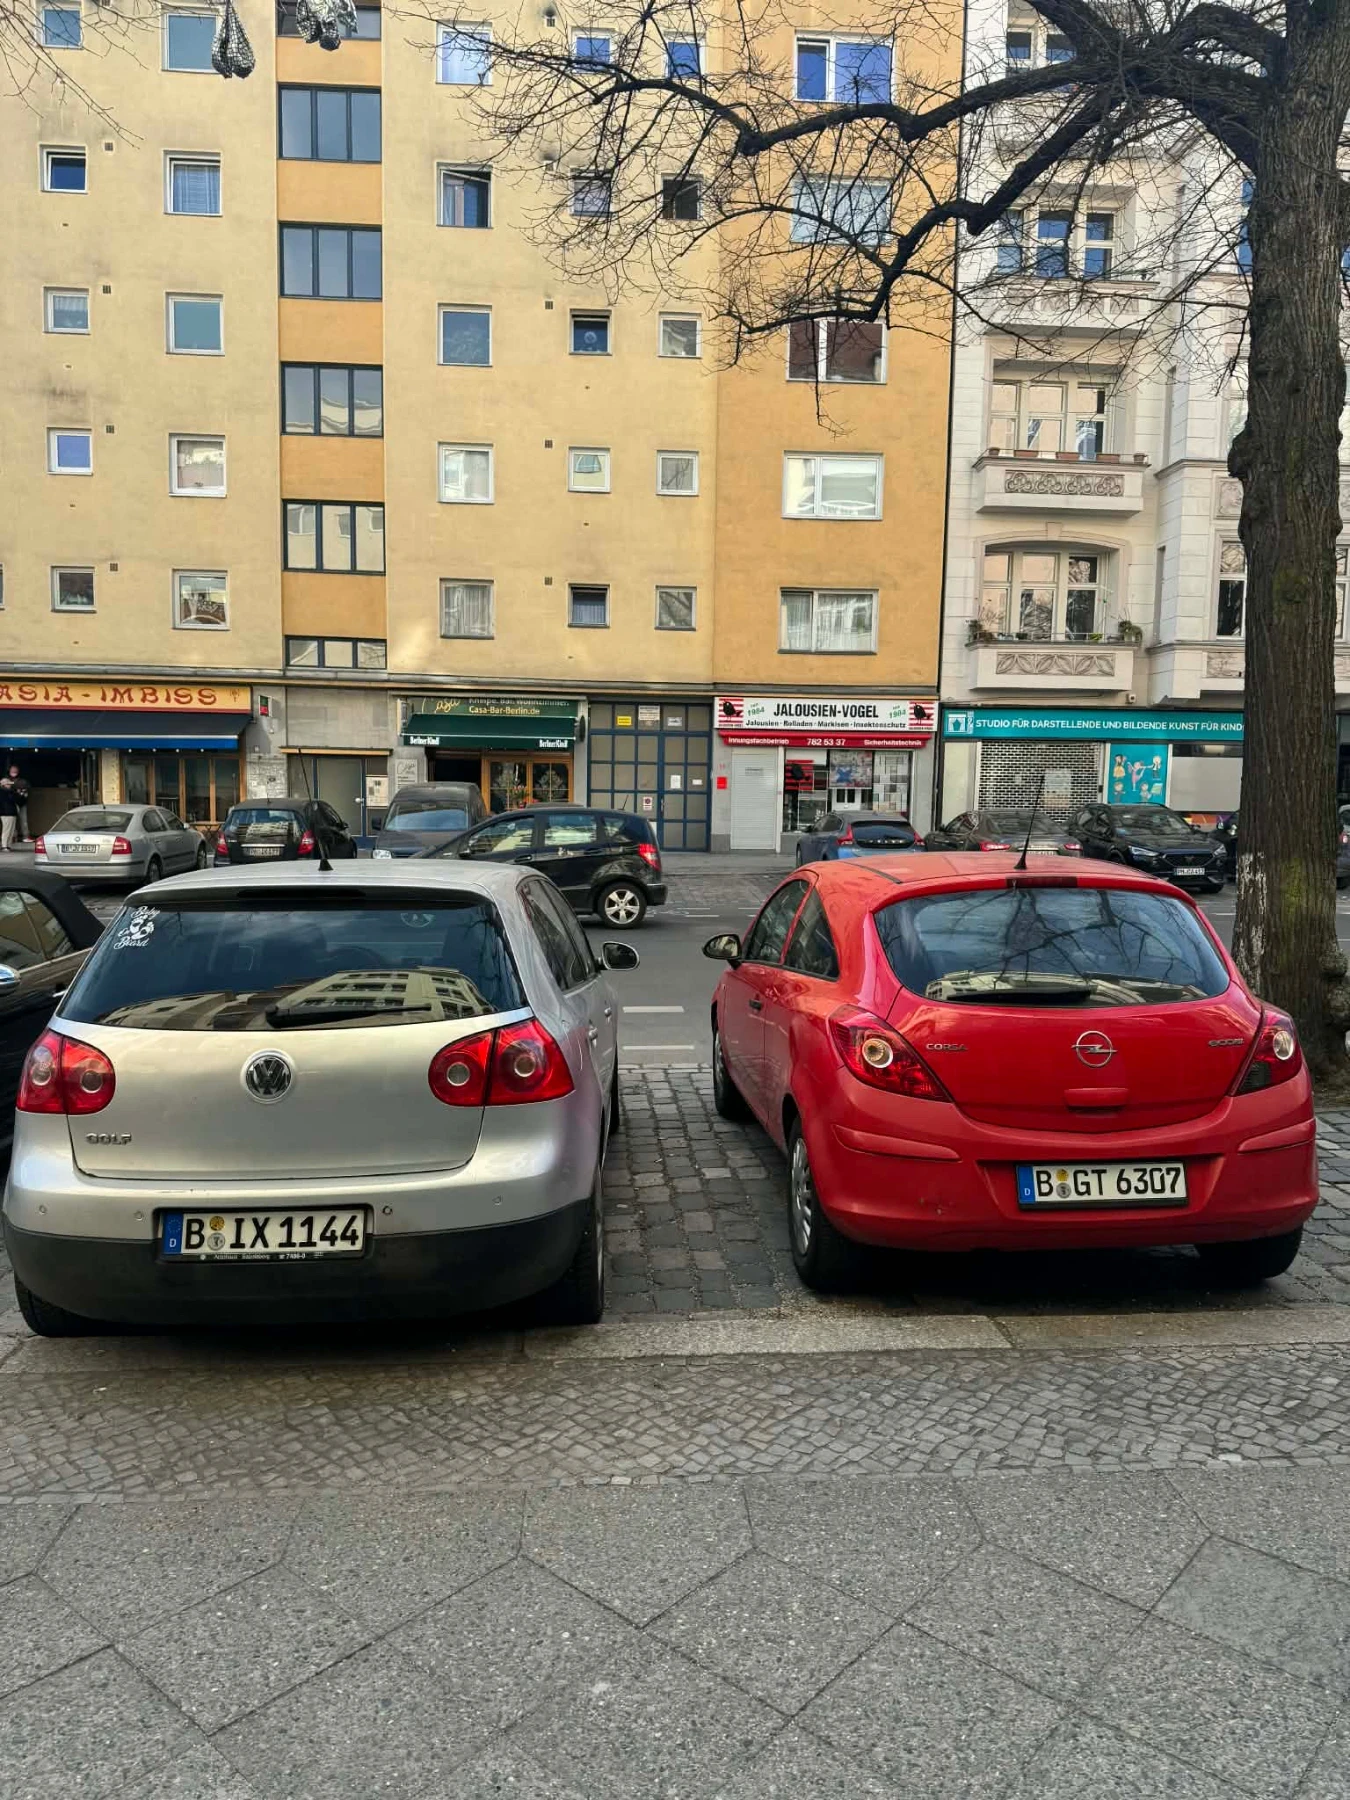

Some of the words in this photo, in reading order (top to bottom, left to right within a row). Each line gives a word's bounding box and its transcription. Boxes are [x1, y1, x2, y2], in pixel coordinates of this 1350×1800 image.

[0, 684, 73, 702] ASIA
[100, 686, 217, 705] IMBISS
[773, 703, 879, 718] JALOUSIEN-VOGEL
[817, 720, 850, 728] Markisen
[975, 719, 1011, 728] STUDIO
[1012, 717, 1030, 728] FÜR
[1031, 719, 1100, 729] DARSTELLENDE
[1102, 721, 1122, 729] UND
[1123, 721, 1167, 730] BILDENDE
[1169, 721, 1200, 731] KUNST
[1200, 720, 1219, 731] FÜR
[1221, 722, 1244, 731] KIND
[806, 738, 822, 746] 782
[823, 738, 834, 746] 53
[85, 1132, 132, 1145] GOLF
[1036, 1170, 1054, 1197] B
[1073, 1169, 1107, 1196] GT
[1116, 1167, 1181, 1195] 6307
[184, 1218, 205, 1250] B
[229, 1217, 270, 1249] IX
[278, 1215, 359, 1248] 1144
